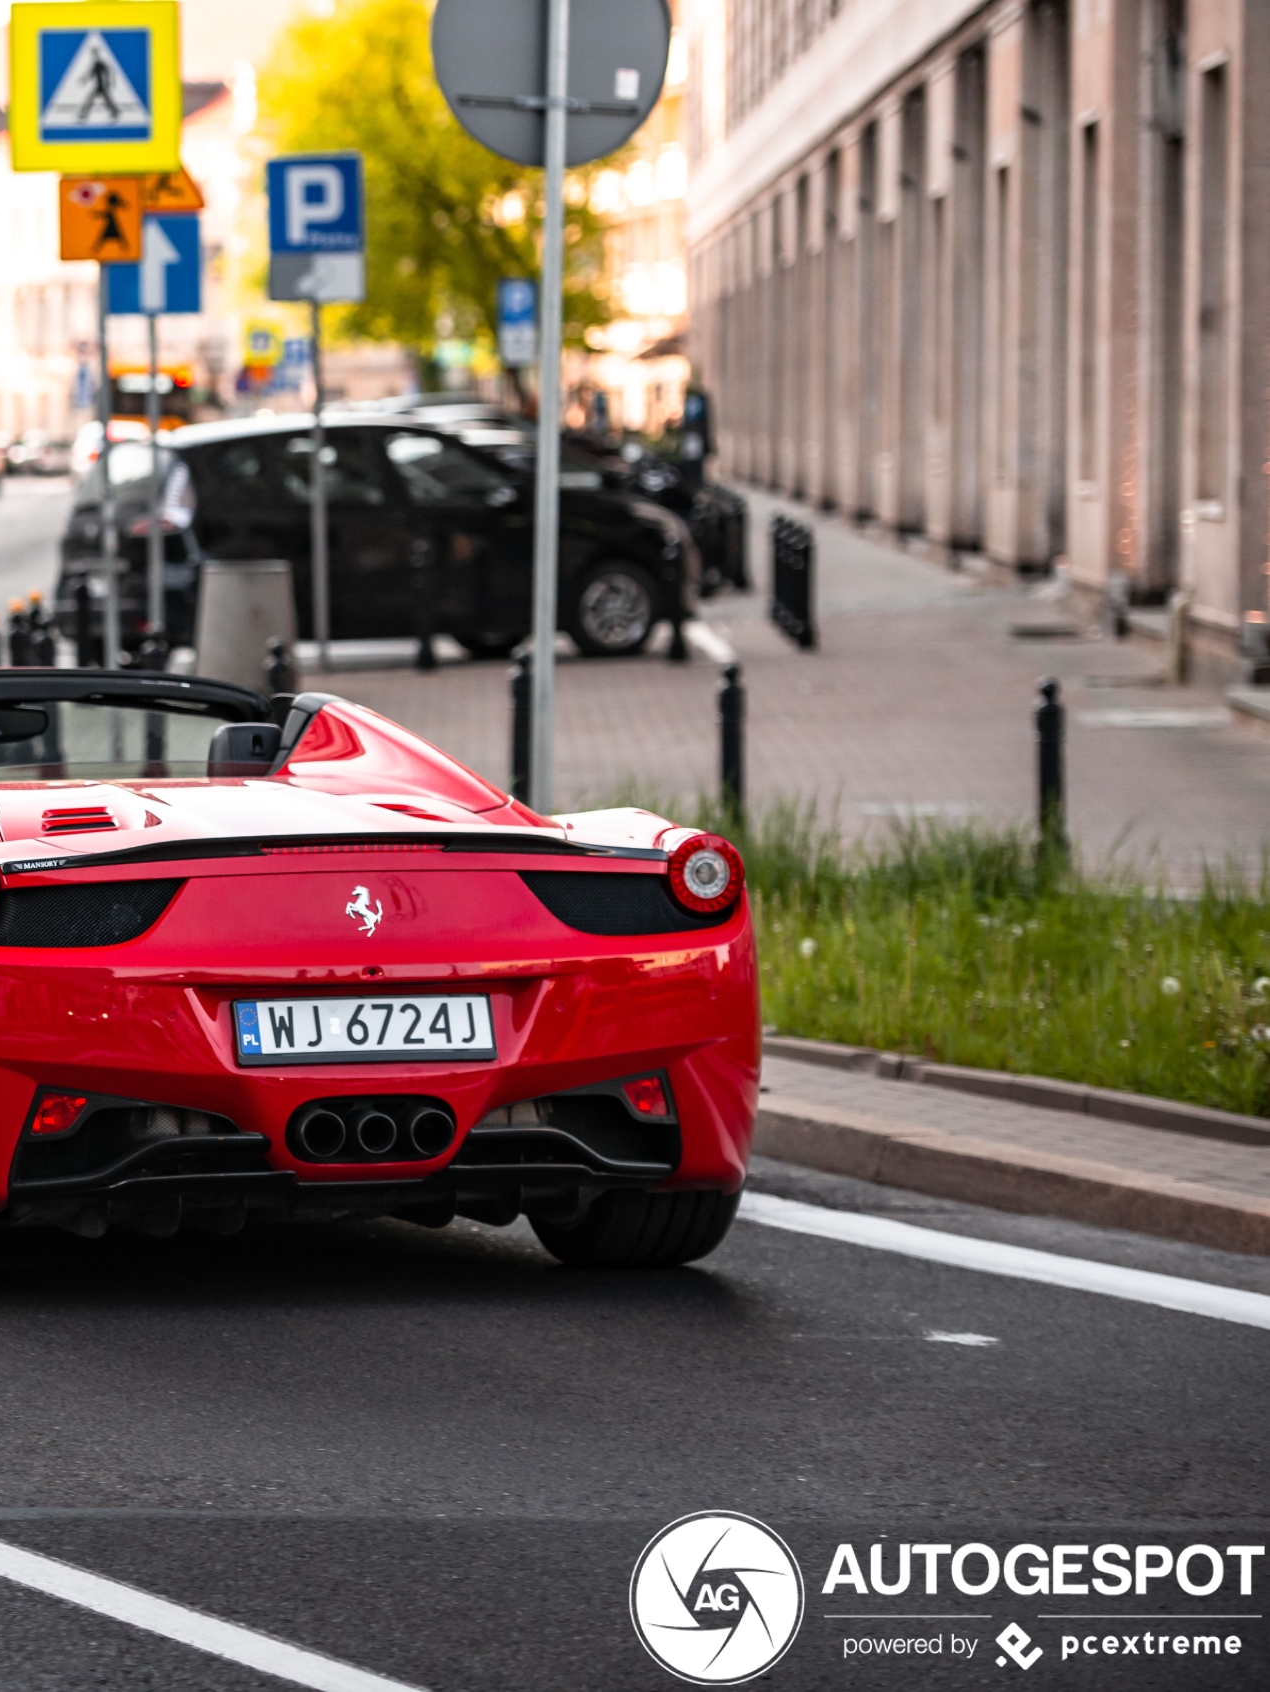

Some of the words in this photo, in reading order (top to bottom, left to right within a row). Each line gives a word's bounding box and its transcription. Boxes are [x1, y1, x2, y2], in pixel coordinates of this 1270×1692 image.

[284, 164, 345, 246] P
[23, 859, 58, 870] MANSORY
[268, 1005, 323, 1048] WJ
[346, 1002, 476, 1046] 6724J
[242, 1034, 259, 1046] PL
